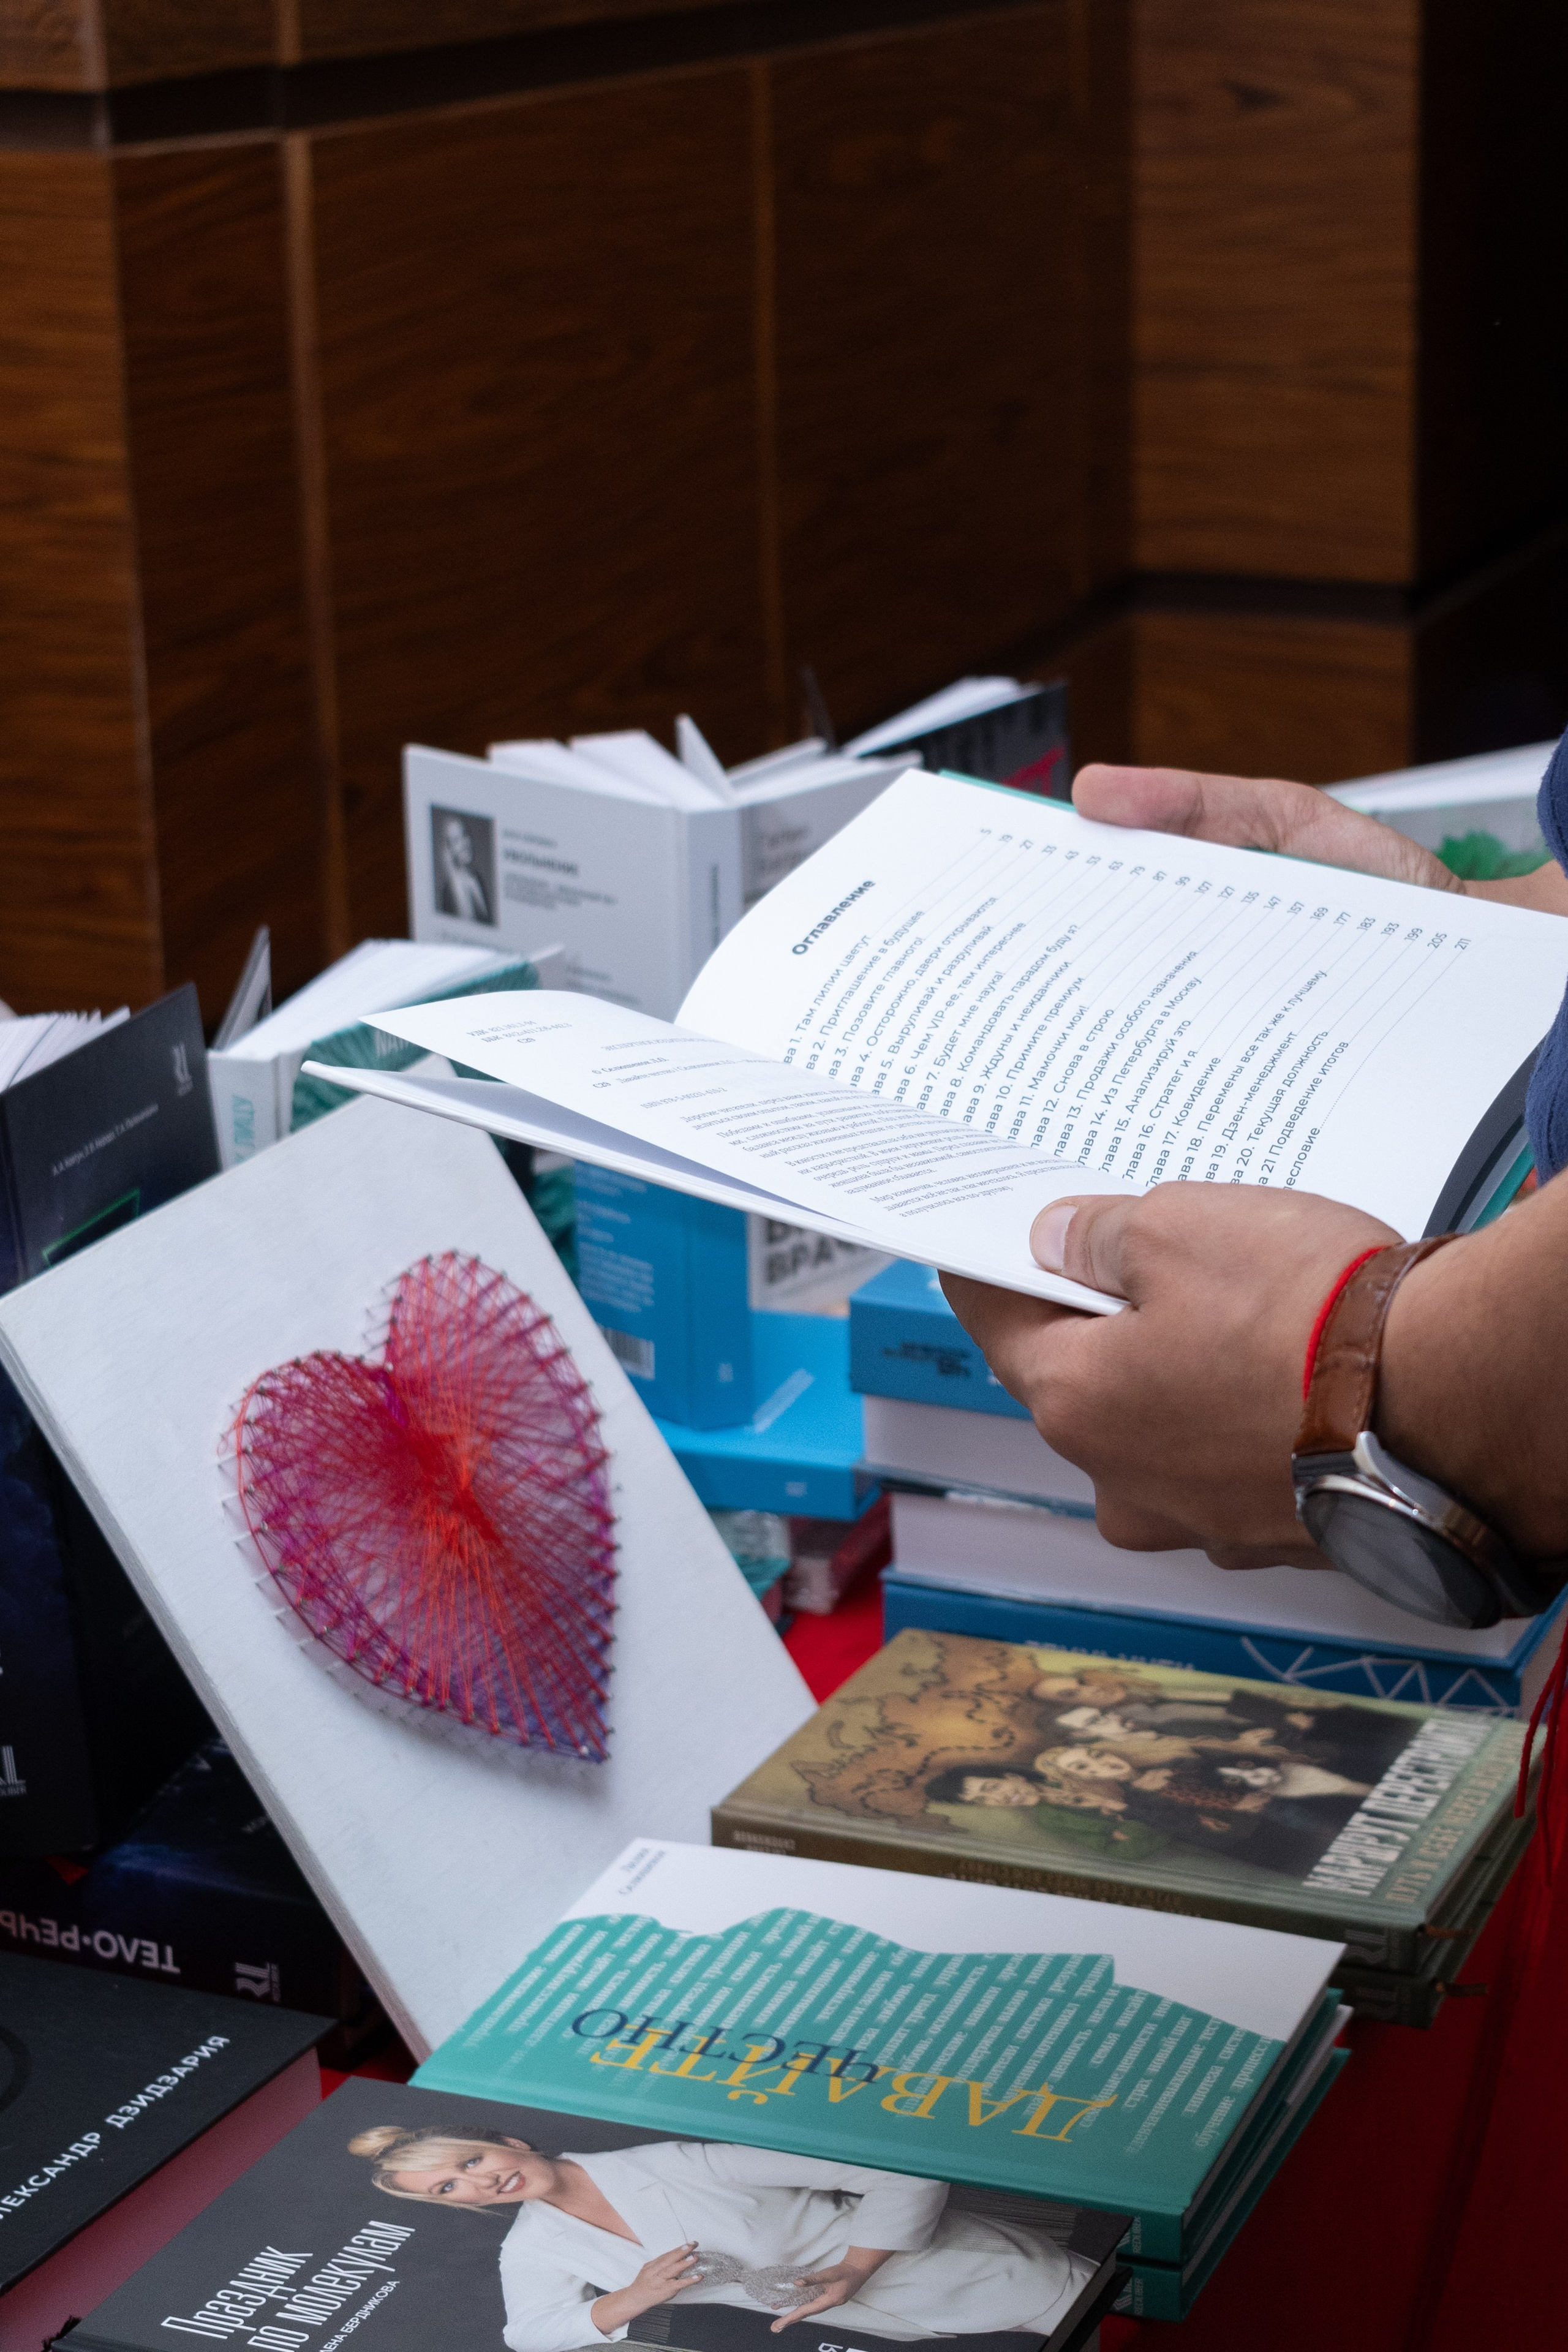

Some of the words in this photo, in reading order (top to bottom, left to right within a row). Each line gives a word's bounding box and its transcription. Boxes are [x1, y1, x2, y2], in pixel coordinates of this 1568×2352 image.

[1108, 861, 1123, 871] 63
[1129, 866, 1145, 875] 79
[1152, 870, 1167, 881] 87
[792, 880, 875, 955] Оглавление
[941, 897, 998, 945] открываются
[1067, 924, 1080, 935] я?
[1427, 933, 1447, 949] 205
[880, 1058, 894, 1069] 5.
[887, 986, 938, 1054] Выруливай
[941, 925, 994, 976] разруливай
[1065, 850, 1079, 861] 43
[914, 946, 944, 977] двери
[973, 922, 1027, 970] интереснее
[1045, 933, 1072, 952] буду
[794, 1008, 816, 1031] Там
[813, 968, 843, 1006] лилии
[839, 934, 870, 967] цветут
[812, 1040, 826, 1050] 2.
[819, 955, 881, 1036] Приглашение
[883, 910, 925, 946] будущее
[834, 1046, 848, 1057] 3.
[842, 984, 885, 1042] Позовите
[881, 936, 925, 982] главного!
[957, 971, 978, 989] тем
[975, 970, 1005, 1003] наука!
[995, 1084, 1013, 1099] 10.
[1005, 1023, 1047, 1080] Примите
[1043, 976, 1085, 1022] премиум
[1175, 876, 1191, 886] 99
[1010, 953, 1050, 993] парадом
[1016, 961, 1071, 1021] нежданчики
[1019, 1094, 1035, 1106] 11.
[1027, 1031, 1069, 1090] Мамочки
[1065, 1005, 1089, 1030] мои!
[1194, 881, 1212, 894] 107
[865, 978, 919, 1046] Осторожно,
[926, 992, 963, 1029] VIP-ее,
[957, 1004, 979, 1027] мне
[1042, 1098, 1060, 1112] 12.
[1053, 1054, 1083, 1093] Снова
[1085, 1009, 1114, 1042] строю
[1218, 886, 1235, 899] 127
[1089, 1109, 1108, 1125] 14.
[1100, 1087, 1118, 1105] Из
[1111, 1019, 1164, 1085] Петербурга
[1164, 976, 1202, 1009] Москву
[1264, 896, 1281, 910] 147
[1114, 1117, 1131, 1131] 15.
[1125, 1038, 1178, 1114] Анализируй
[1173, 1020, 1191, 1037] это
[1287, 901, 1305, 914] 157
[1137, 1123, 1156, 1138] 16.
[1148, 1068, 1183, 1118] Стратег
[1180, 1059, 1191, 1068] и
[1310, 907, 1329, 920] 169
[910, 1032, 933, 1059] Чем
[956, 994, 1014, 1072] Командовать
[1009, 1023, 1020, 1031] и
[1053, 1123, 1074, 1157] лава
[1066, 1104, 1083, 1118] 13.
[1076, 1041, 1118, 1100] Продажи
[1115, 999, 1151, 1040] особого
[1147, 951, 1198, 998] назначения
[1241, 891, 1259, 904] 135
[1161, 1130, 1179, 1145] 17.
[1171, 1057, 1221, 1126] Ковидение
[1333, 911, 1351, 925] 177
[1186, 1136, 1204, 1152] 18.
[1196, 1065, 1245, 1131] Перемены
[1240, 1044, 1259, 1063] все
[1254, 1026, 1273, 1042] так
[1268, 1012, 1285, 1027] же
[1286, 970, 1327, 1006] лучшему
[1357, 917, 1376, 931] 183
[1210, 1143, 1229, 1158] 19.
[1221, 1031, 1297, 1140] Дзен-менеджмент
[1381, 922, 1400, 935] 193
[1236, 1146, 1254, 1166] 20.
[1246, 1088, 1286, 1141] Текущая
[1281, 1031, 1329, 1088] должность
[1404, 928, 1423, 941] 199
[859, 1050, 872, 1062] 4.
[903, 1064, 918, 1074] 6.
[932, 1029, 961, 1067] Будет
[979, 1033, 1014, 1080] Ждуны
[1283, 1127, 1320, 1189] есловие
[1454, 938, 1471, 950] 211
[1317, 1041, 1349, 1076] итогов
[925, 1071, 940, 1080] 7.
[949, 1076, 964, 1087] 8.
[972, 1083, 987, 1094] 9.
[1268, 1077, 1322, 1156] Подведение
[815, 1170, 848, 1180] очередь
[871, 1156, 901, 1166] супруги
[846, 1179, 893, 1193] задуманное
[935, 1176, 967, 1186] человек
[1261, 1158, 1276, 1173] 21
[907, 1200, 954, 1215] получилось
[670, 1945, 710, 1982] система
[731, 1952, 763, 1980] семья
[571, 2008, 880, 2082] ЧЕСТНО
[1144, 2037, 1178, 2071] новый
[1173, 2016, 1193, 2035] шаг
[590, 2024, 1118, 2142] ДАВАЙТЕ
[1124, 2078, 1156, 2108] страх
[0, 2132, 101, 2219] ЛЕКСАНДР
[105, 2035, 230, 2128] ДЗИДЗАРИЯ
[160, 2246, 314, 2339] Праздник
[276, 2220, 416, 2326] молекулам
[247, 2326, 310, 2352] по
[320, 2333, 348, 2352] ЛЕНА
[340, 2280, 400, 2334] БЕРДНИКОВА
